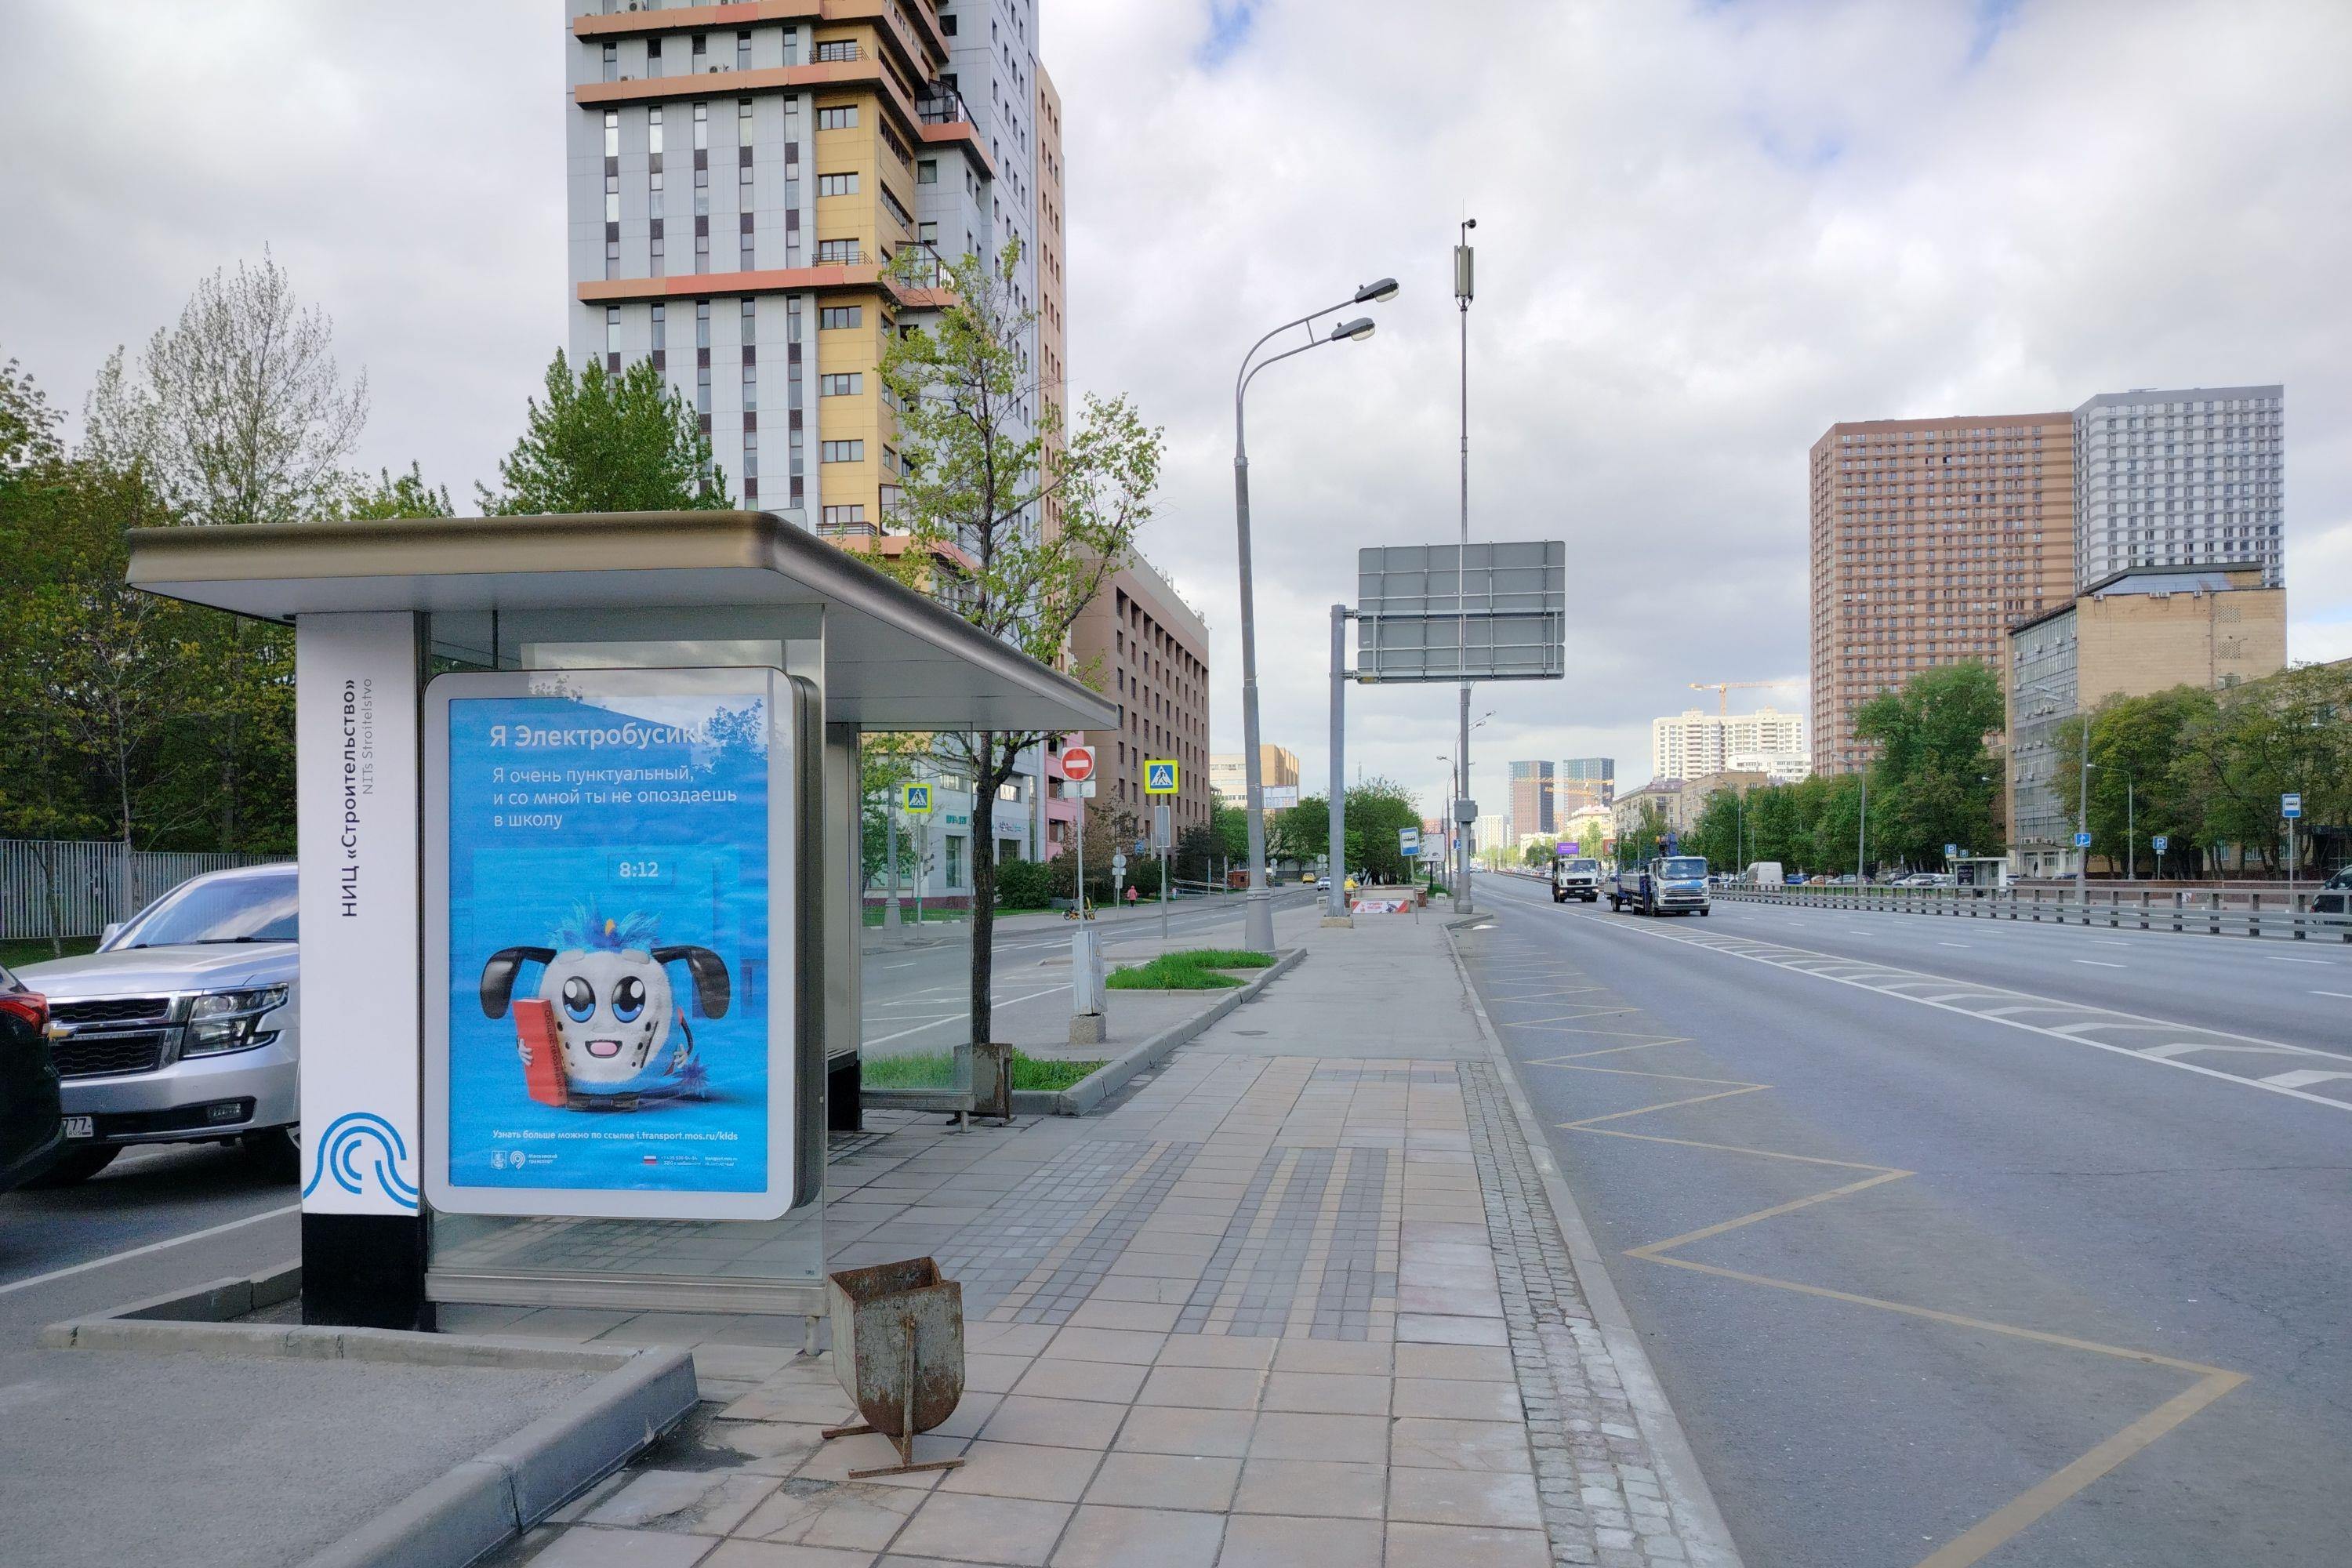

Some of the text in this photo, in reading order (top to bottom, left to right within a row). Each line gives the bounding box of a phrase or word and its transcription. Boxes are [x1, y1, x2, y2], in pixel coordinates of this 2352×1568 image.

[361, 678, 373, 794] NITs Stroitelstvo
[489, 721, 702, 750] Я Электробусик!
[492, 764, 695, 786] Я очень пунктуальный,
[341, 679, 360, 916] НИЦ «Строительство»
[493, 789, 738, 805] и со мной ты не опоздаешь
[494, 813, 563, 830] в школу
[619, 862, 659, 878] 8:12
[492, 1129, 739, 1142] Узнать больше можно по ссылке i.transport.mos.ru/kids
